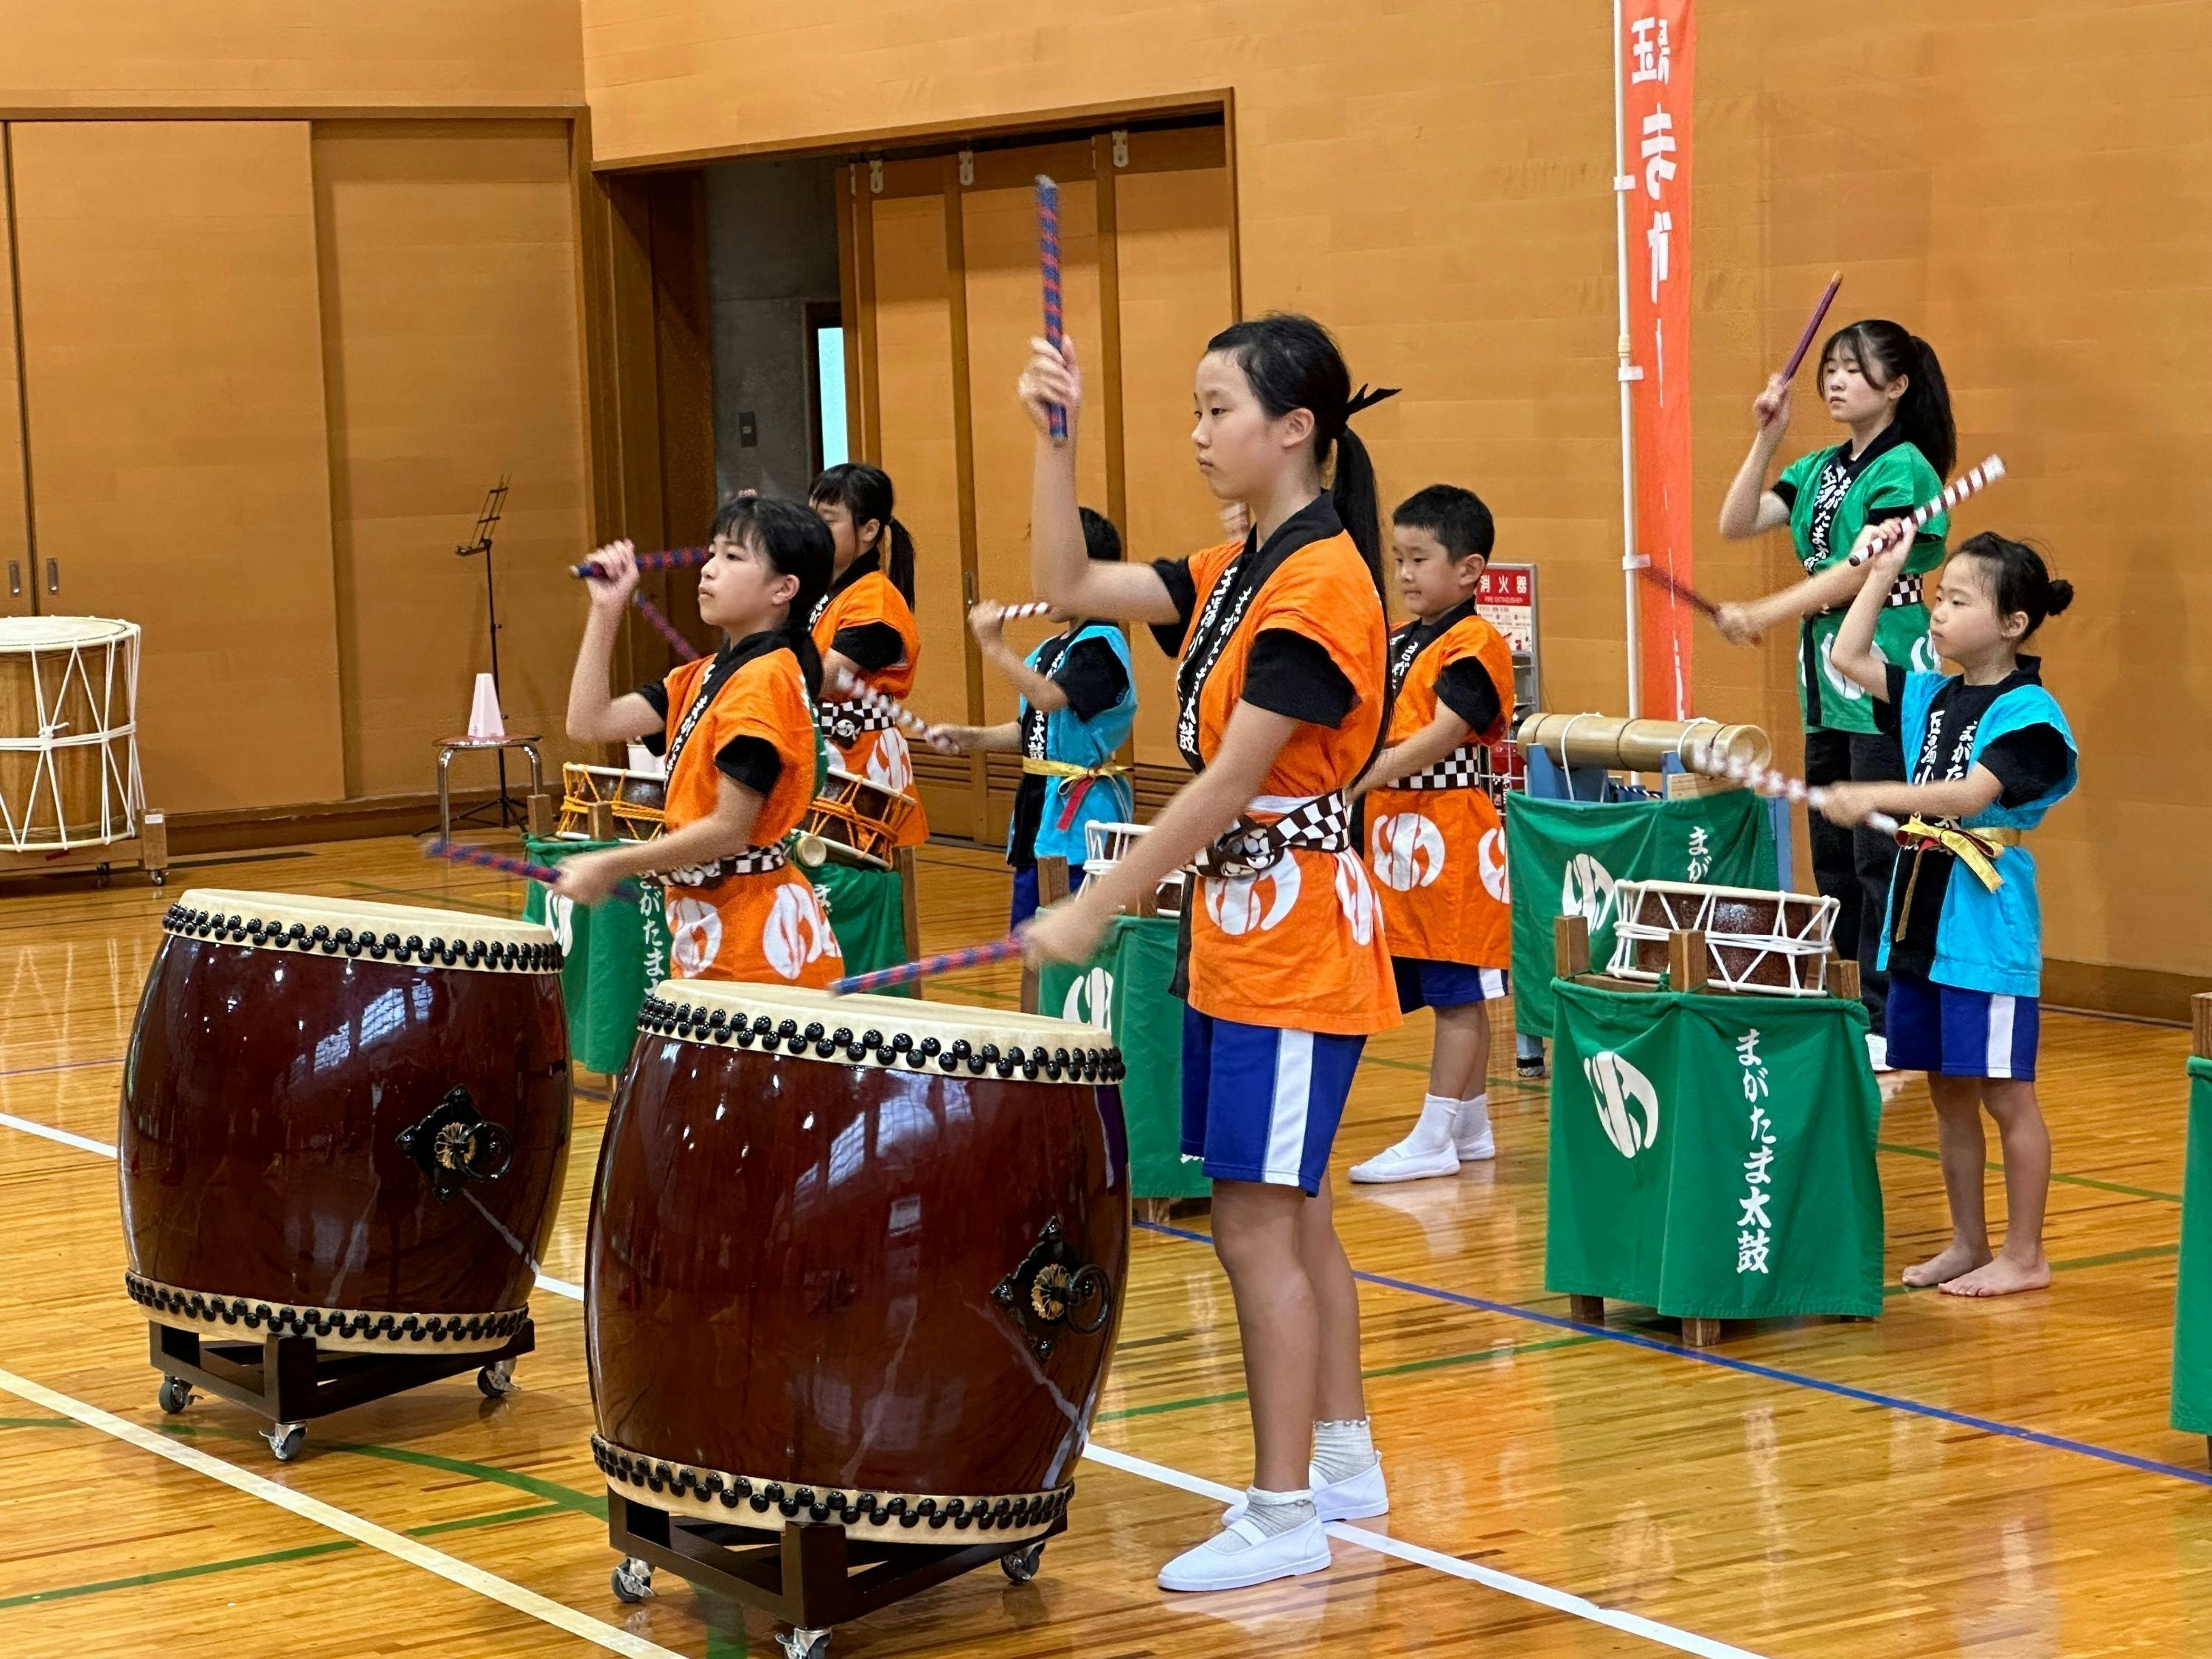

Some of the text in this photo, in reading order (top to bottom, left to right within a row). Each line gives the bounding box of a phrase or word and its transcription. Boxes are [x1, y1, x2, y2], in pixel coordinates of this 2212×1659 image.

[1479, 574, 1527, 594] 消火器
[639, 879, 665, 997] がたま
[1735, 1029, 1777, 1274] まがたま太鼓
